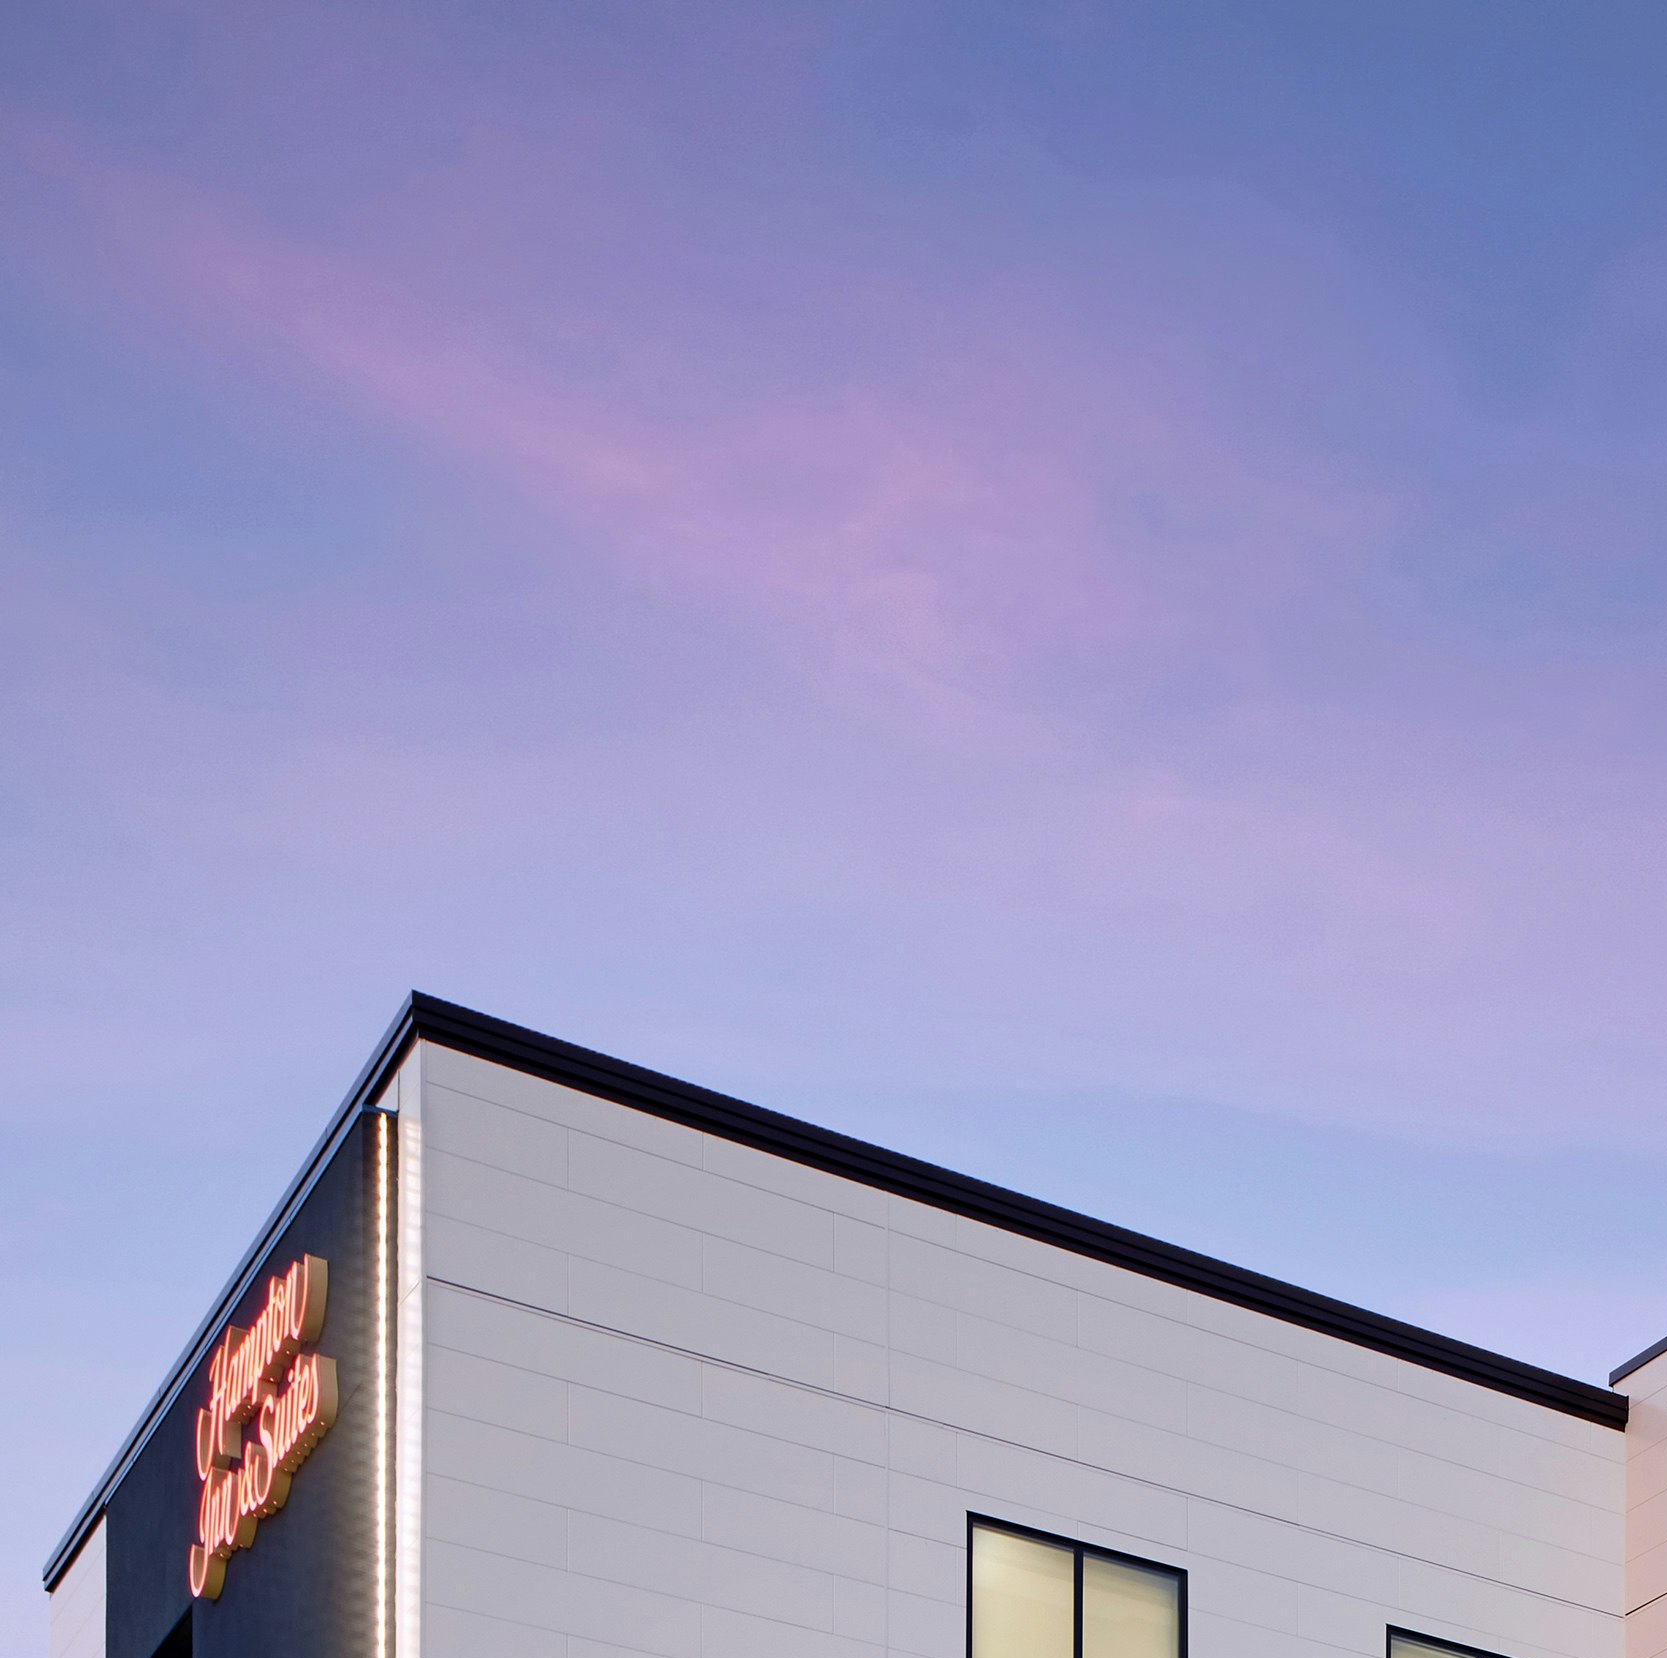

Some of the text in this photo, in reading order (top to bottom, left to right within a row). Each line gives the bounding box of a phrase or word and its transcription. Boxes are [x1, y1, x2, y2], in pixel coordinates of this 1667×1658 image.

[189, 1466, 241, 1598] Inn
[254, 1353, 322, 1506] Suites
[197, 1253, 311, 1481] Hampton
